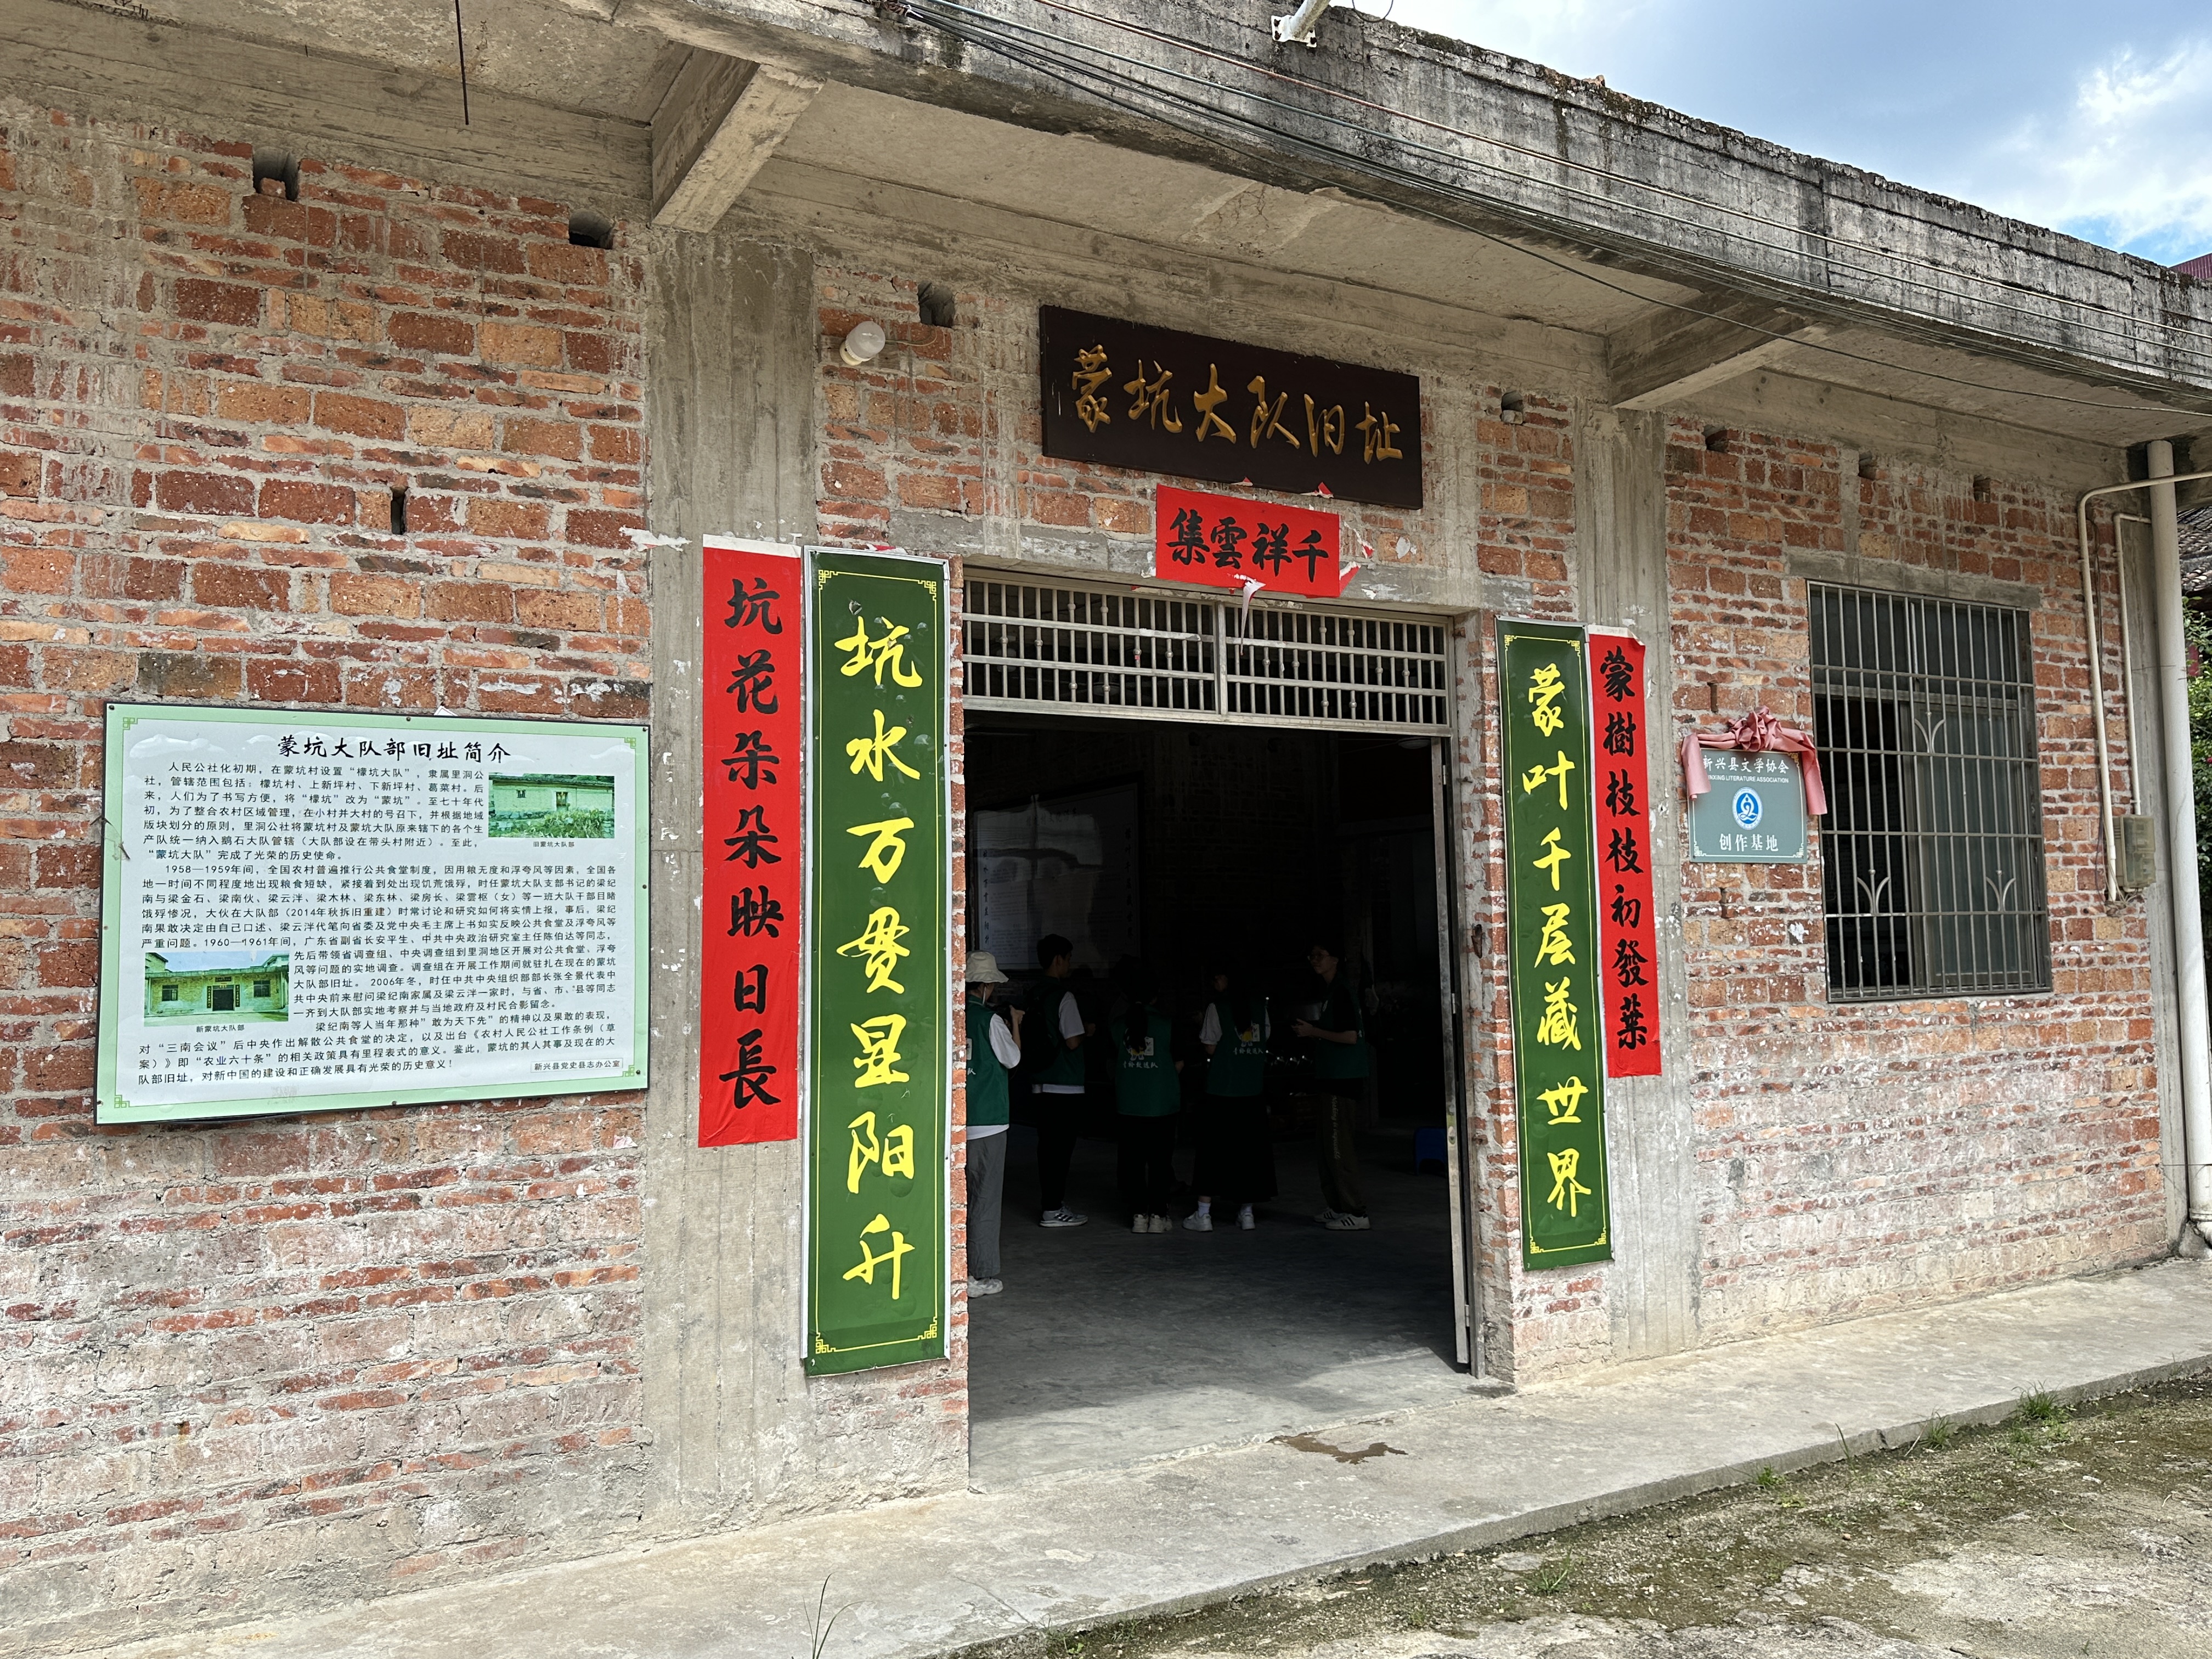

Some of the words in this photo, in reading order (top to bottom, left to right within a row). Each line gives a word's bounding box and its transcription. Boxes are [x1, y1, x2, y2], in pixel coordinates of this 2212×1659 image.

[1072, 344, 1403, 464] 蒙坑大队旧址
[278, 735, 511, 763] 蒙坑大队部旧址简介
[1703, 755, 1789, 774] 新兴县文学协会
[719, 578, 783, 1109] 坑花朵朵映日長
[1600, 646, 1648, 1049] 蒙樹枝枝初發葉
[1719, 833, 1778, 851] 创作基地
[196, 1024, 245, 1032] 新蒙坑大队部
[534, 1060, 620, 1070] 新兴县党史县志办公室
